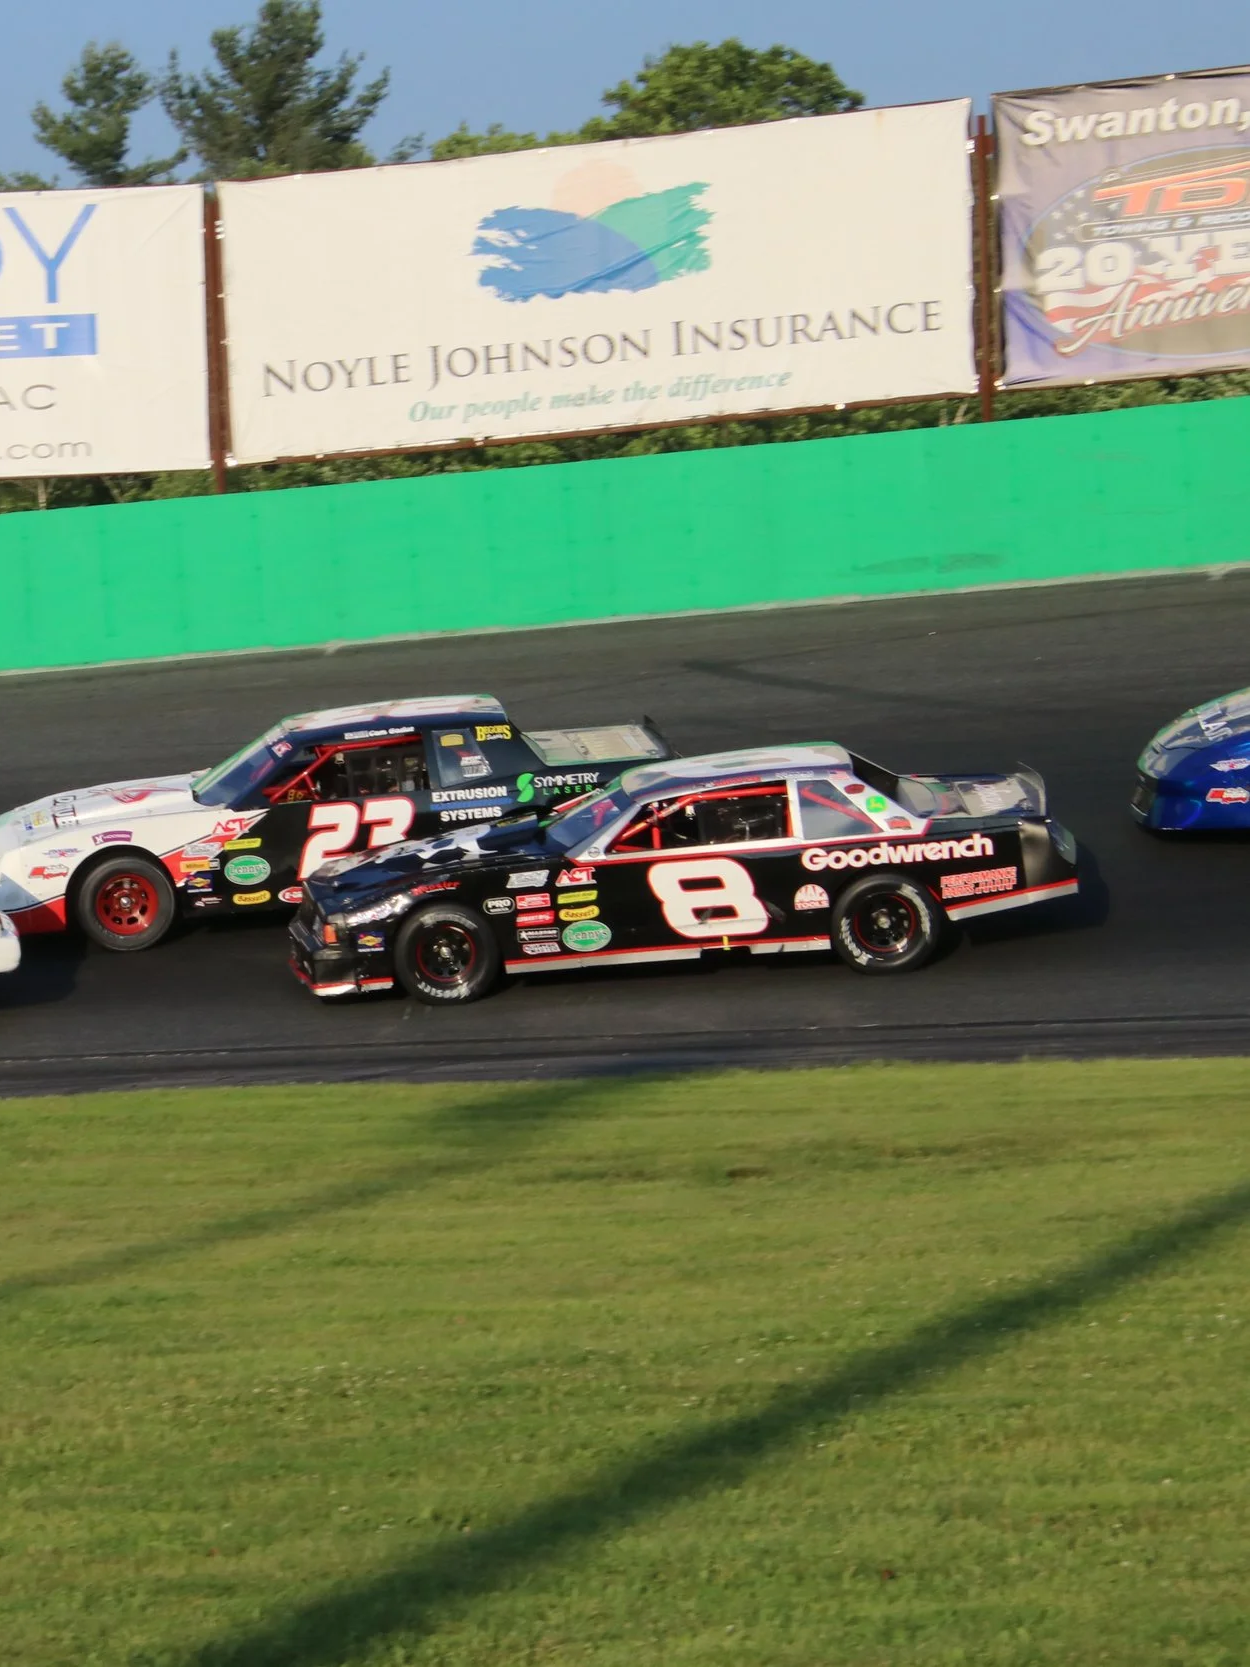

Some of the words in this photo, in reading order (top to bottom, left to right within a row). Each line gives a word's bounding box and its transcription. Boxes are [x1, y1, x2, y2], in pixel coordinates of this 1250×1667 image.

[1035, 241, 1137, 292] 20
[260, 351, 413, 398] NOYLE
[424, 327, 653, 390] JOHNSON
[670, 299, 944, 357] INSURANCE
[406, 399, 457, 424] Our
[463, 391, 541, 419] people
[549, 381, 617, 410] make
[622, 377, 662, 402] the
[667, 367, 793, 401] difference
[533, 772, 600, 788] SYMMETRY
[542, 784, 594, 796] LASER
[431, 786, 508, 802] EXTRUSION
[440, 806, 503, 822] SYSTEMS
[298, 796, 416, 880] 23
[801, 833, 994, 871] Goodwrench
[555, 867, 597, 884] ACT
[940, 866, 1017, 887] PERFORMANCE
[487, 899, 511, 908] PRO
[647, 857, 769, 938] 8
